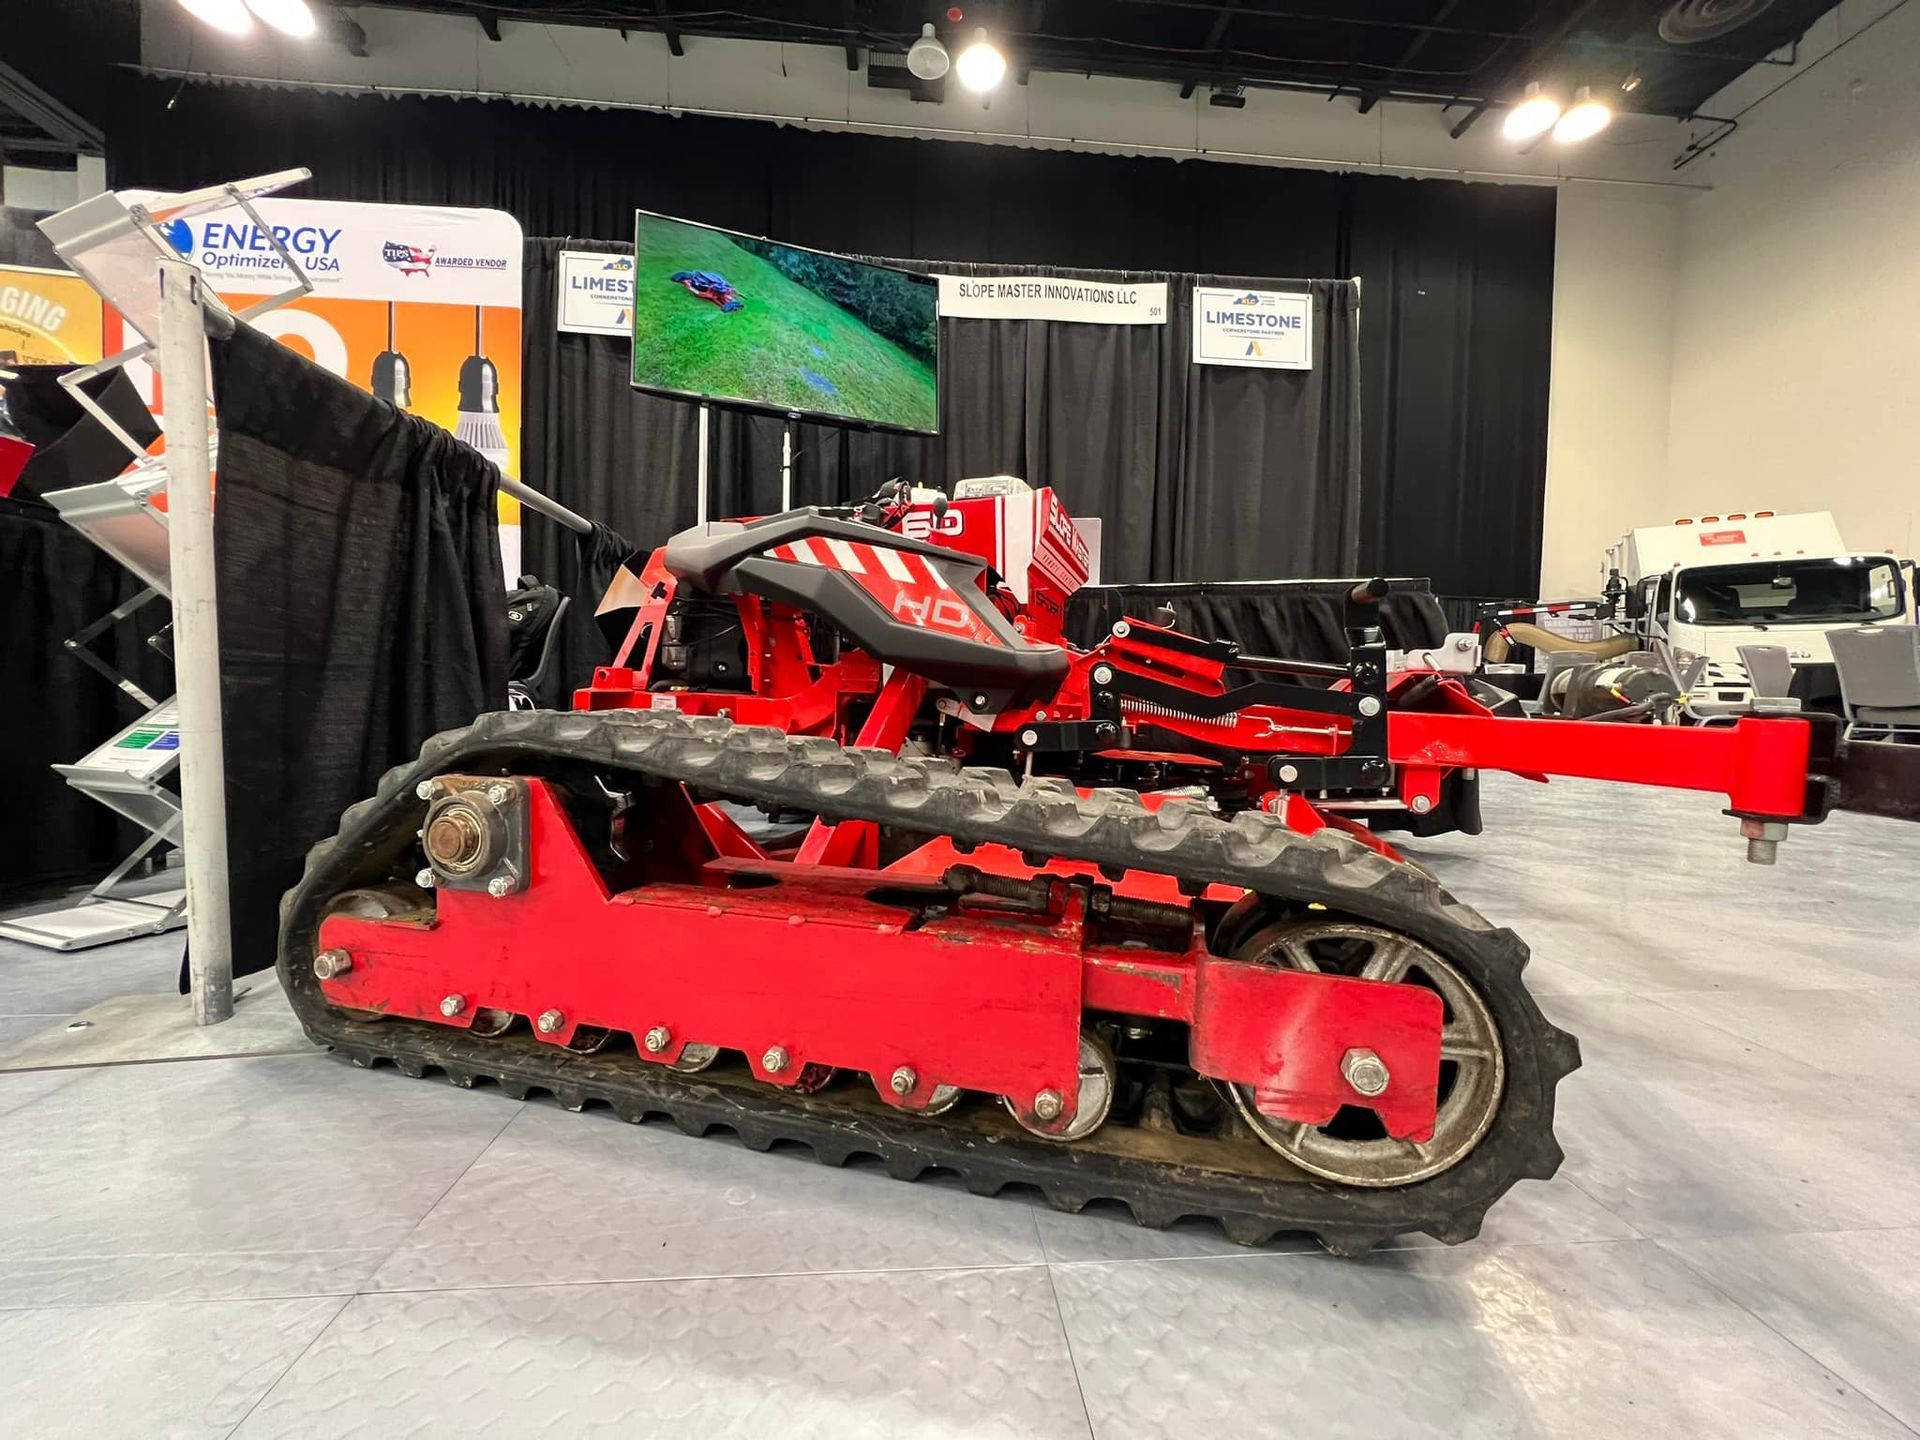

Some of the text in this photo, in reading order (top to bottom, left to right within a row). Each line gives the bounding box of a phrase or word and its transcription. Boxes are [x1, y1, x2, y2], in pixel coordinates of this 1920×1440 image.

[202, 222, 342, 254] ENERGY
[202, 251, 340, 271] Optimizer USA
[384, 248, 410, 259] TIPS
[434, 257, 507, 268] AWARDED VENDOR
[959, 283, 1137, 304] SLOPE MASTER INNOVATIONS LLC
[1149, 306, 1162, 316] 501
[1206, 310, 1302, 329] LIMESTONE
[892, 588, 969, 628] HD
